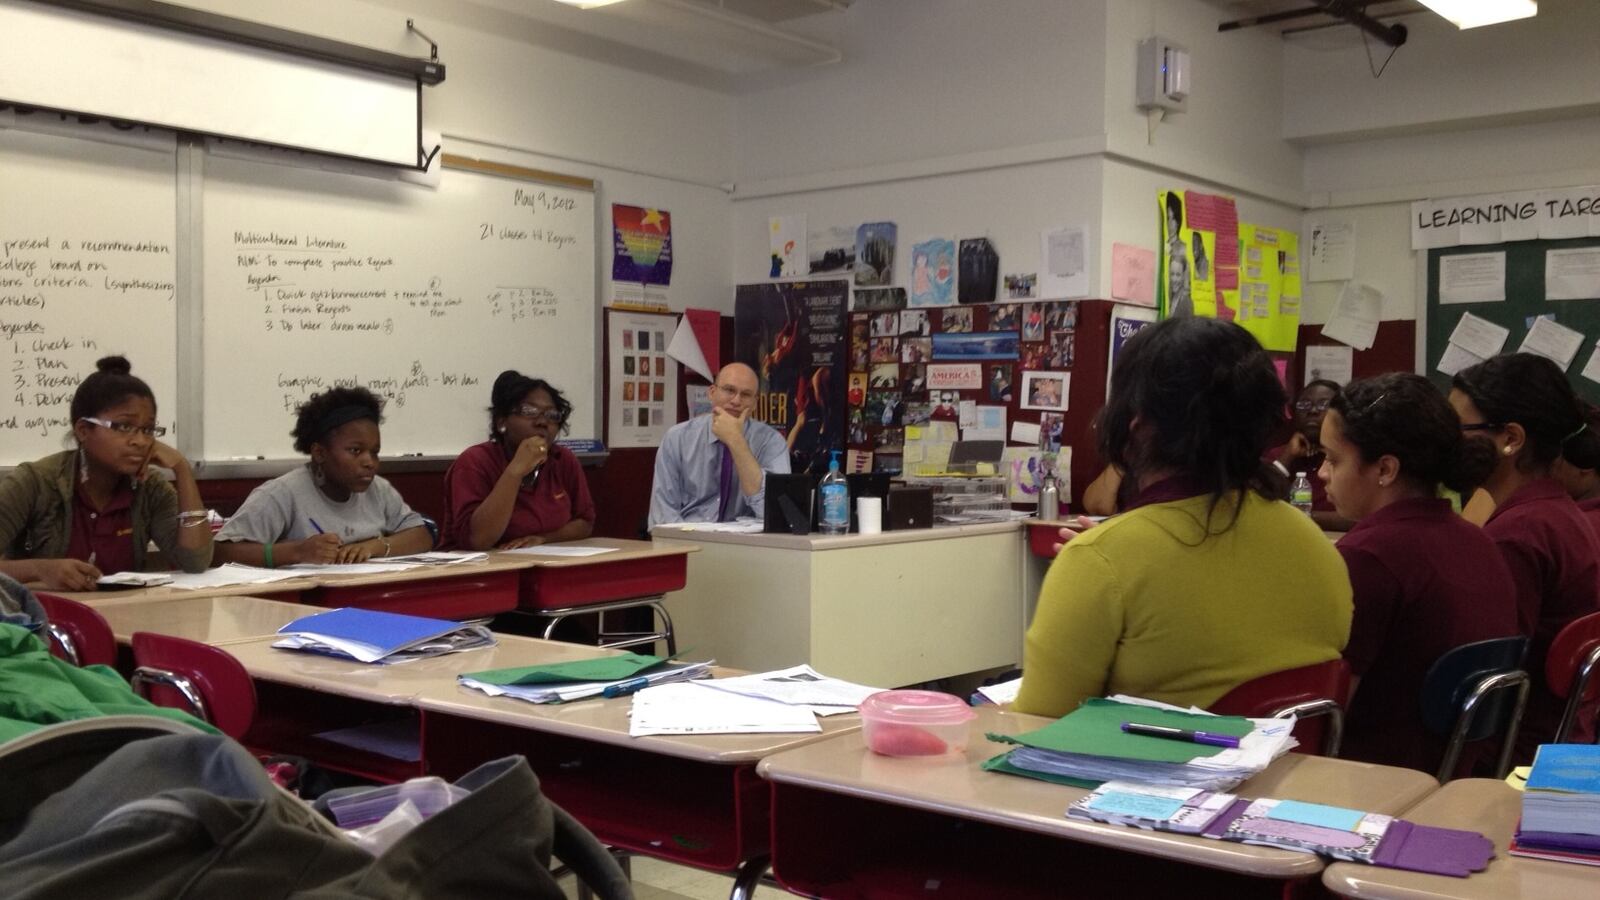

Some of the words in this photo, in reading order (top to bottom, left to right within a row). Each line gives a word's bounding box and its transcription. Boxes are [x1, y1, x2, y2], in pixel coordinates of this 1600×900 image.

[514, 189, 535, 214] May
[552, 196, 576, 210] 2012
[1418, 202, 1537, 229] LEARNING
[234, 231, 298, 247] Multicultural
[305, 235, 347, 249] Literature
[480, 223, 494, 240] 21
[5, 237, 49, 257] present
[61, 240, 71, 250] a
[81, 240, 170, 254] recommendation
[50, 260, 82, 272] board
[87, 262, 107, 272] on
[266, 254, 278, 267] To
[284, 258, 323, 271] complete
[247, 273, 281, 291] Agenda
[282, 304, 312, 315] Finish
[32, 338, 73, 351] Check
[82, 337, 98, 350] in
[35, 356, 69, 370] Plan
[278, 373, 324, 393] Graphic
